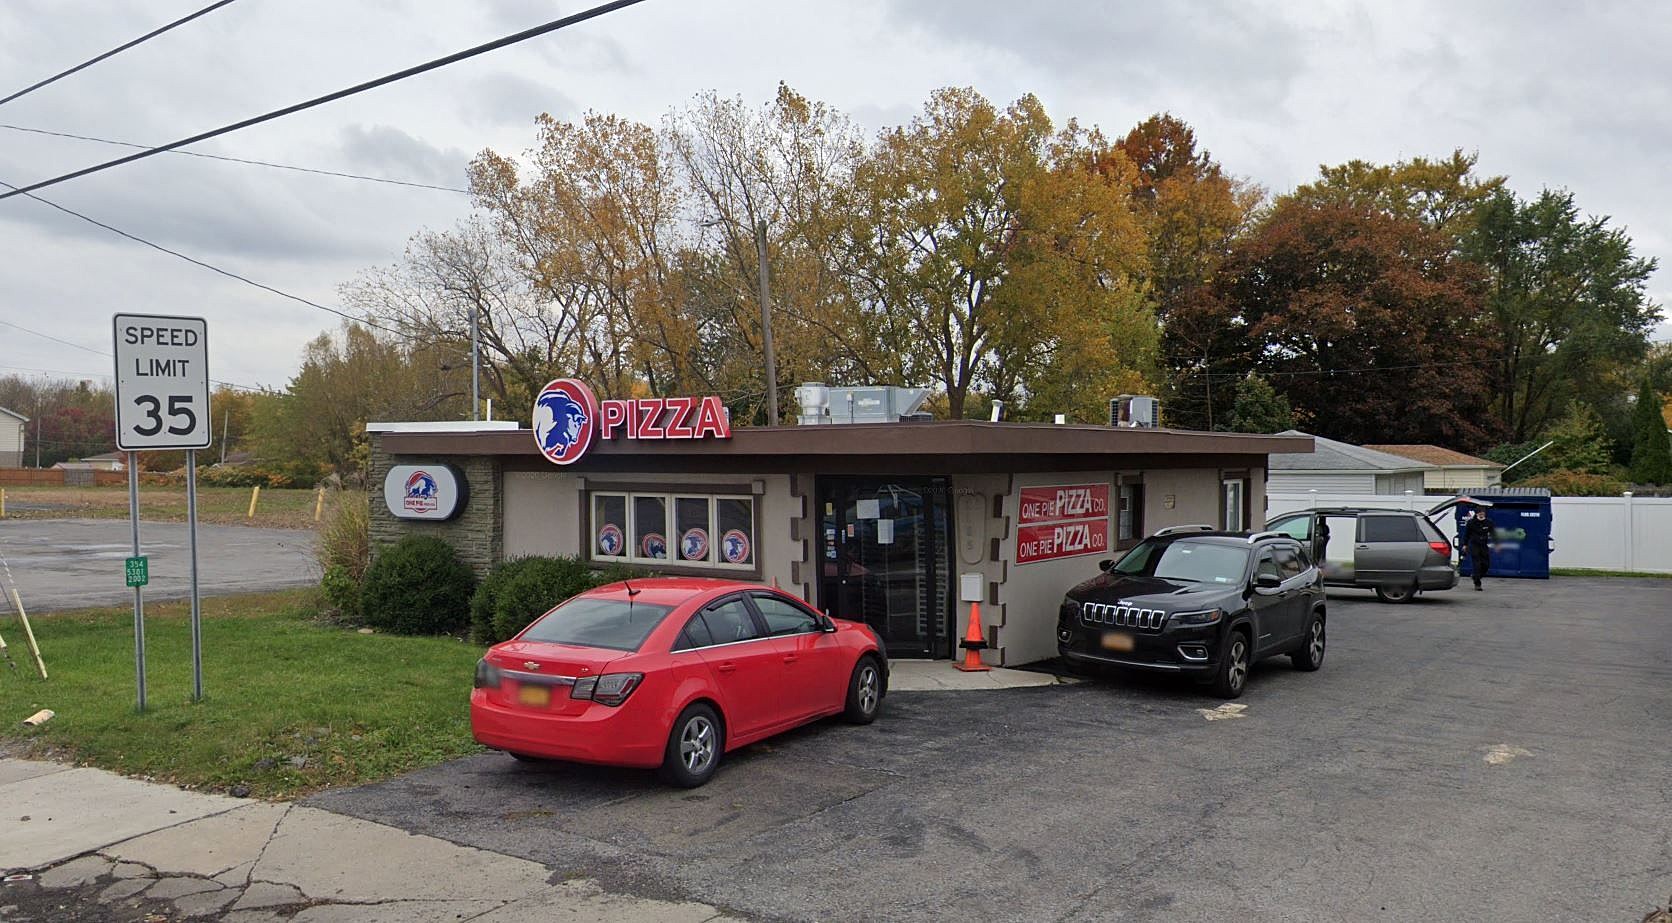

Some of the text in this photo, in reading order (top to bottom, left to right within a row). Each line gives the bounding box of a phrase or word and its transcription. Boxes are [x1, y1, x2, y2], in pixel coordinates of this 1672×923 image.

[125, 326, 198, 347] SPEED
[135, 358, 190, 377] LIMIT
[133, 394, 197, 436] 35
[602, 397, 728, 440] PIZZA
[1022, 488, 1106, 519] ONE PIE PIZZA CO.
[1020, 525, 1105, 557] ONE PIE PIZZA CO.
